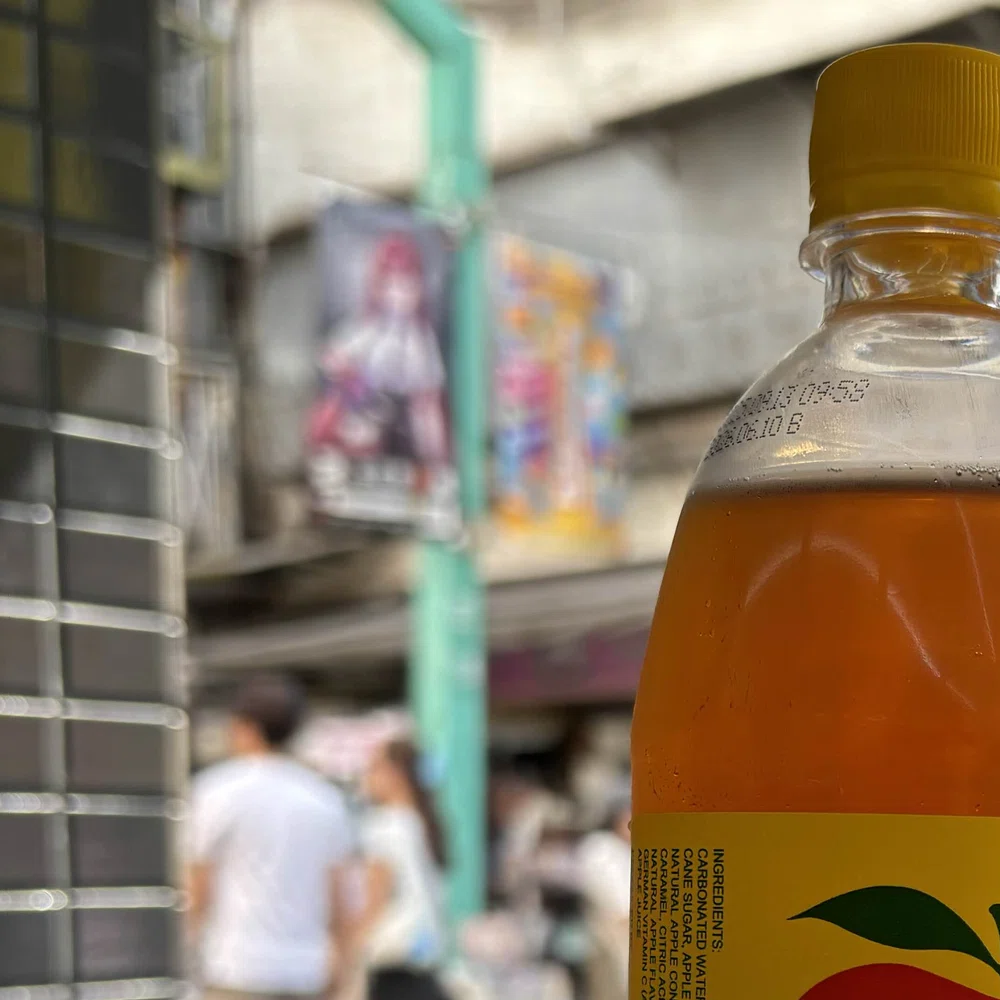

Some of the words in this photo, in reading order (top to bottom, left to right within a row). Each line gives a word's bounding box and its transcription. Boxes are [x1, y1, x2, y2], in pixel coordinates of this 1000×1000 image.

[799, 379, 869, 405] 09:58
[650, 849, 658, 913] NATURAL
[659, 849, 668, 921] CARAMEL,
[670, 849, 679, 915] NATURAL
[683, 849, 693, 888] CANE
[681, 893, 692, 948] SUGAR,
[697, 849, 708, 949] CARBONATED
[712, 849, 724, 952] INGREDIENTS:
[649, 919, 657, 964] APPLE
[659, 926, 667, 973] CITRIC
[670, 920, 678, 965] APPLE
[641, 976, 647, 985] C
[682, 953, 691, 999] APPLE
